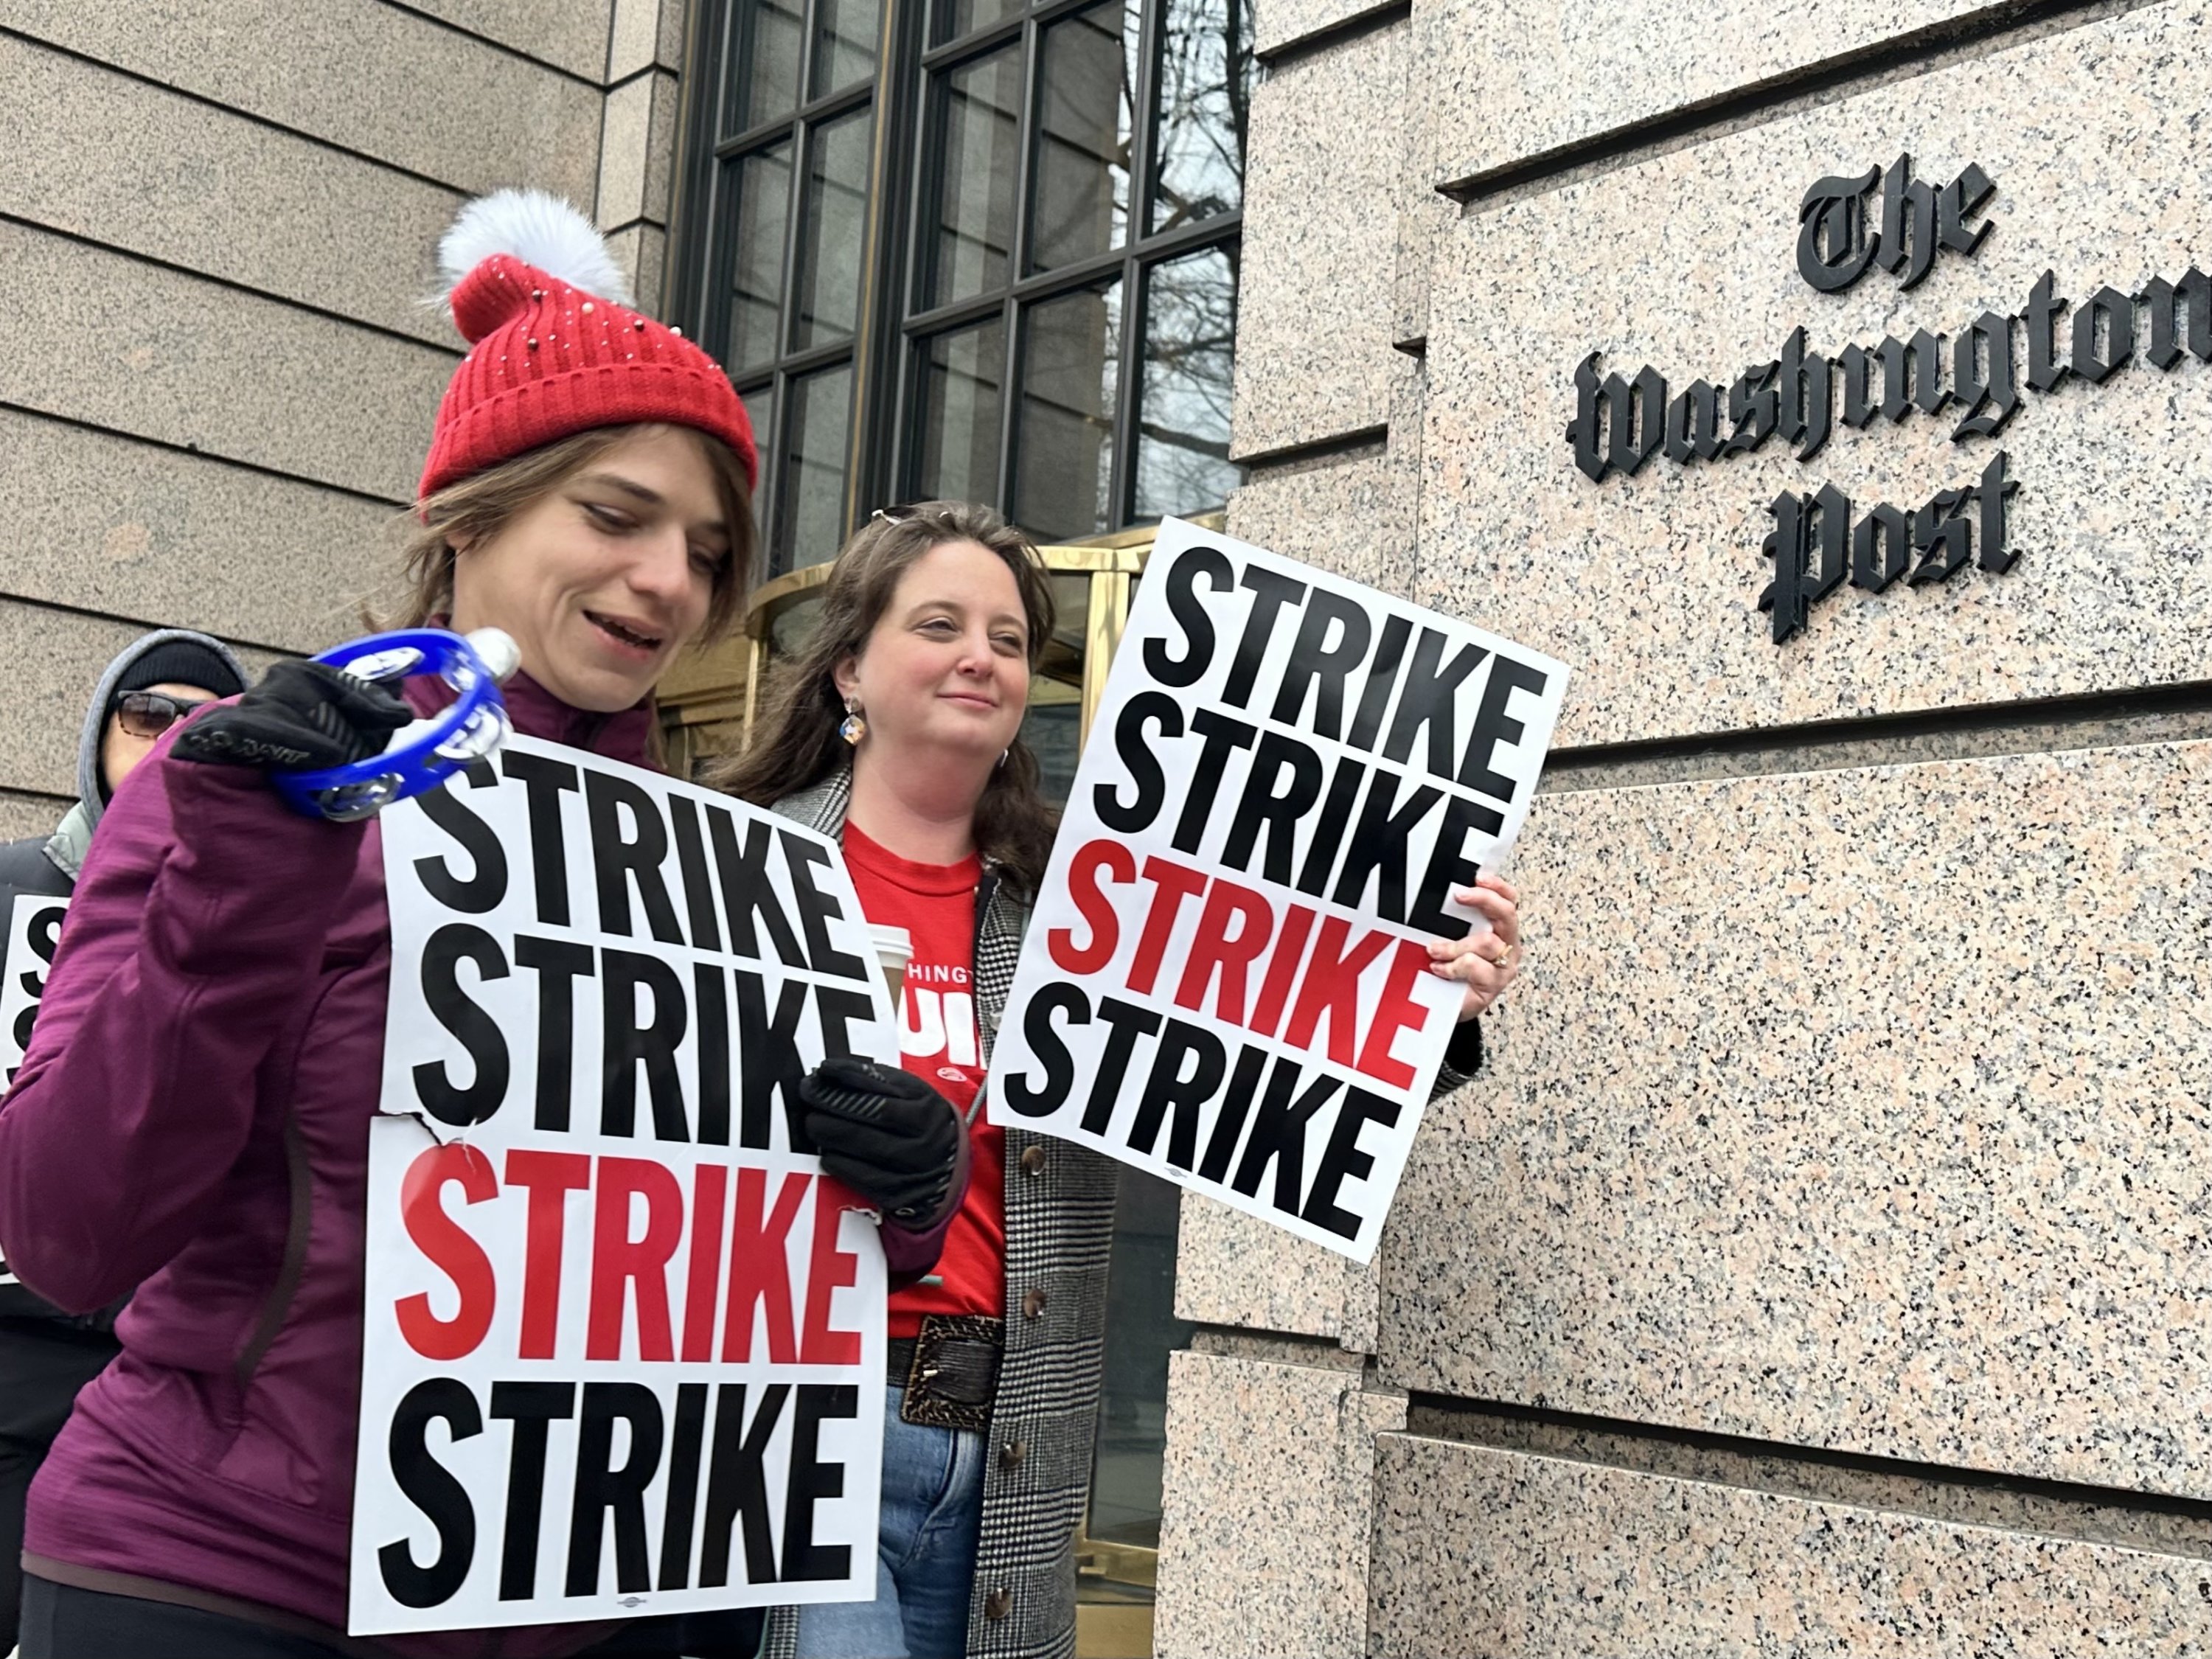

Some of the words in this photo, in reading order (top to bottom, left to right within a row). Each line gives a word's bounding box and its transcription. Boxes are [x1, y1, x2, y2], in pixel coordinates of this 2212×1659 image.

[1797, 152, 1997, 292] The
[1758, 450, 2023, 645] Post
[1143, 547, 1548, 804] STRIKE
[414, 748, 869, 983] STRIKE
[1093, 691, 1505, 940] STRIKE
[897, 986, 987, 1070] UI
[908, 963, 973, 984] HING
[1048, 839, 1435, 1091] STRIKE
[1004, 981, 1402, 1242] STRIKE
[394, 1144, 879, 1365] STRIKE
[378, 1377, 859, 1609] STRIKE
